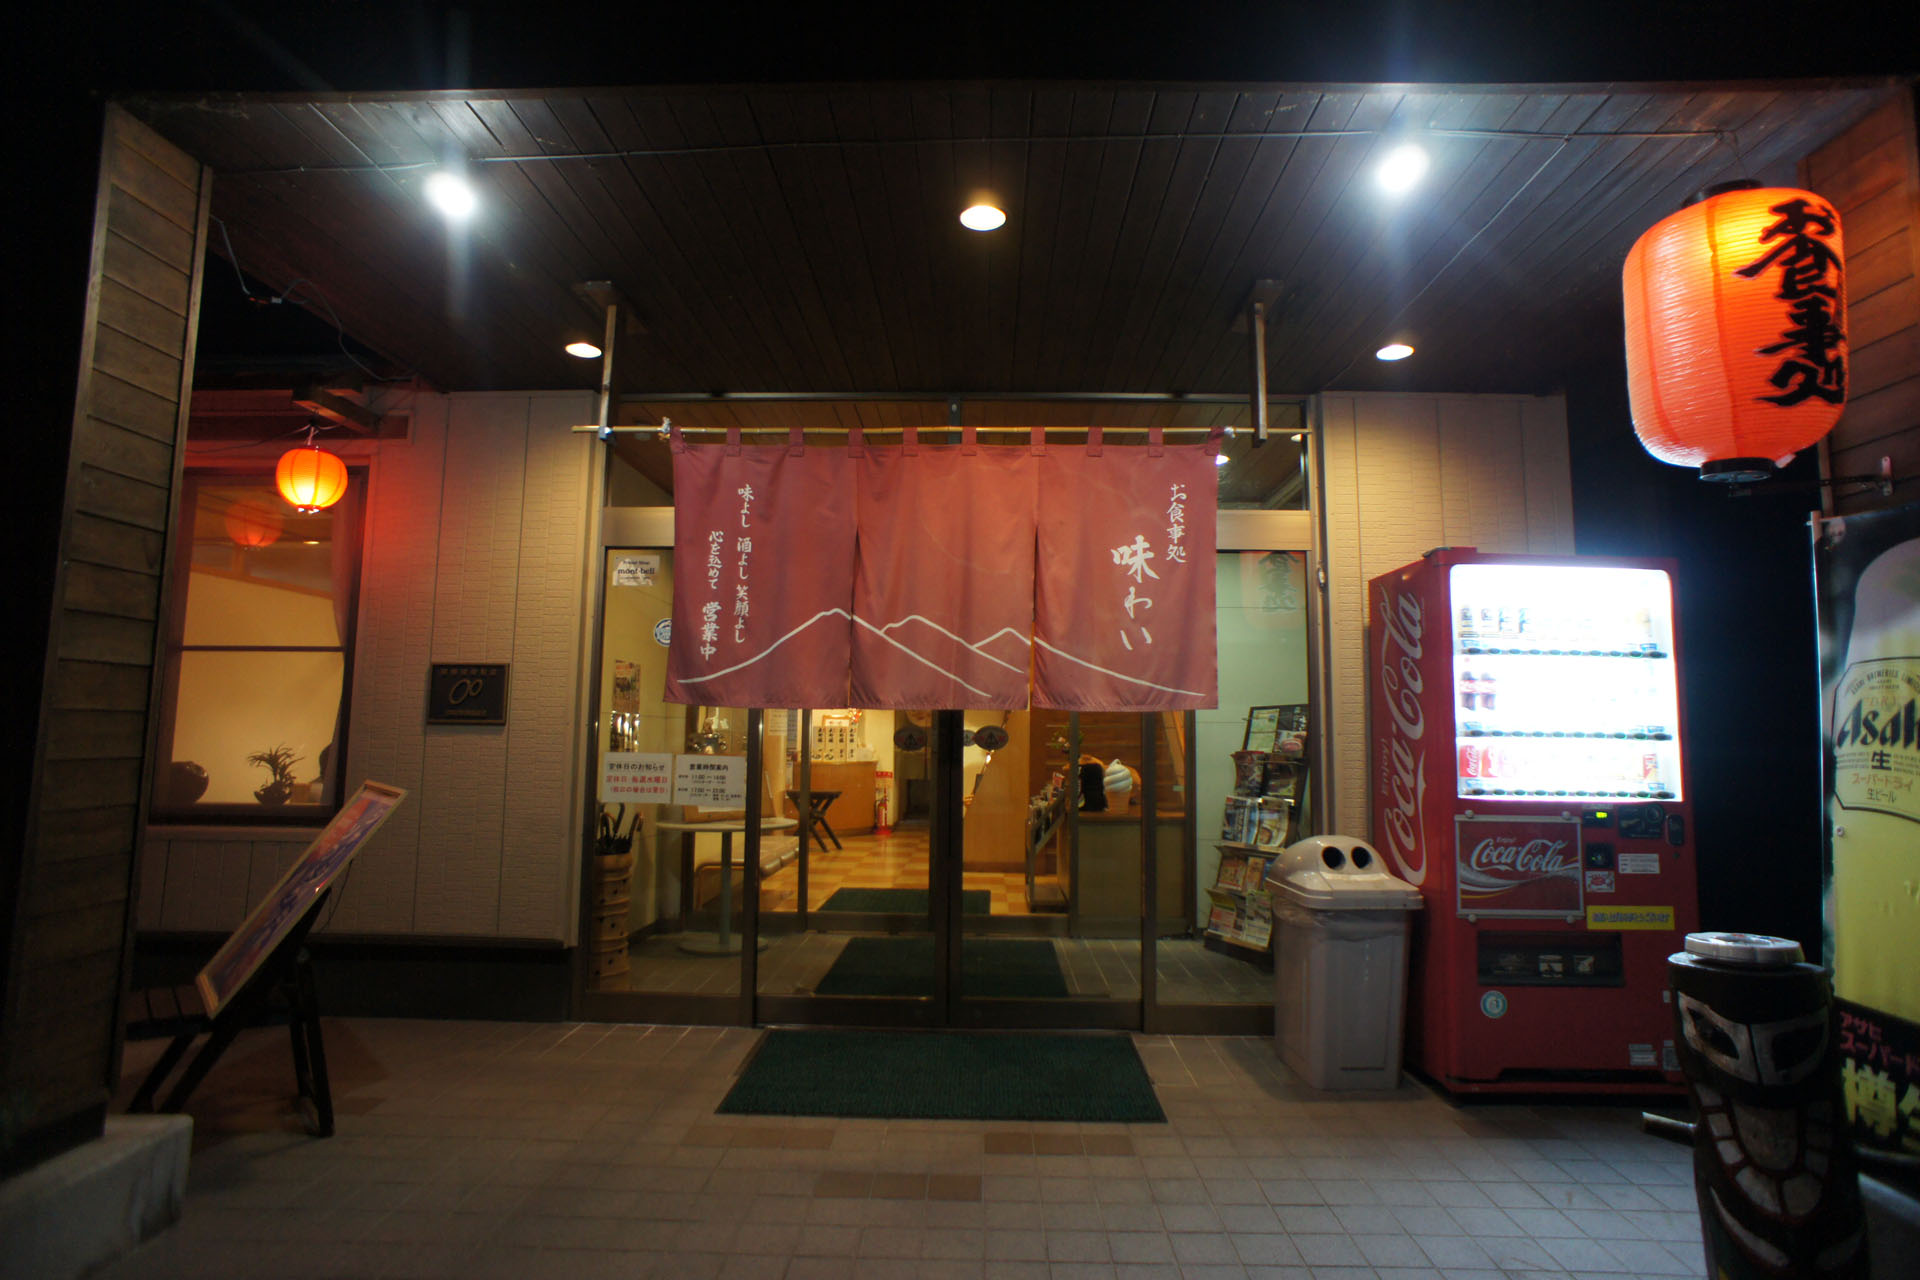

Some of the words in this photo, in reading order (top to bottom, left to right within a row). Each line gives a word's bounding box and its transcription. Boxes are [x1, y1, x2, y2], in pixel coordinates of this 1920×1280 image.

[737, 484, 755, 528] 味よし
[1165, 483, 1188, 564] お食事処
[707, 530, 724, 590] 心を込めて
[736, 537, 752, 580] 酒よし
[733, 584, 750, 644] 笑顔よし
[1110, 534, 1161, 651] 味わい
[700, 601, 722, 661] 営業中
[1379, 583, 1427, 886] Coca-Cola
[1851, 772, 1914, 792] スーパードライ
[1871, 750, 1892, 771] 生
[1866, 787, 1897, 803] 生ビール
[1470, 838, 1569, 873] Coca-Cola
[1839, 1010, 1883, 1041] アサヒ
